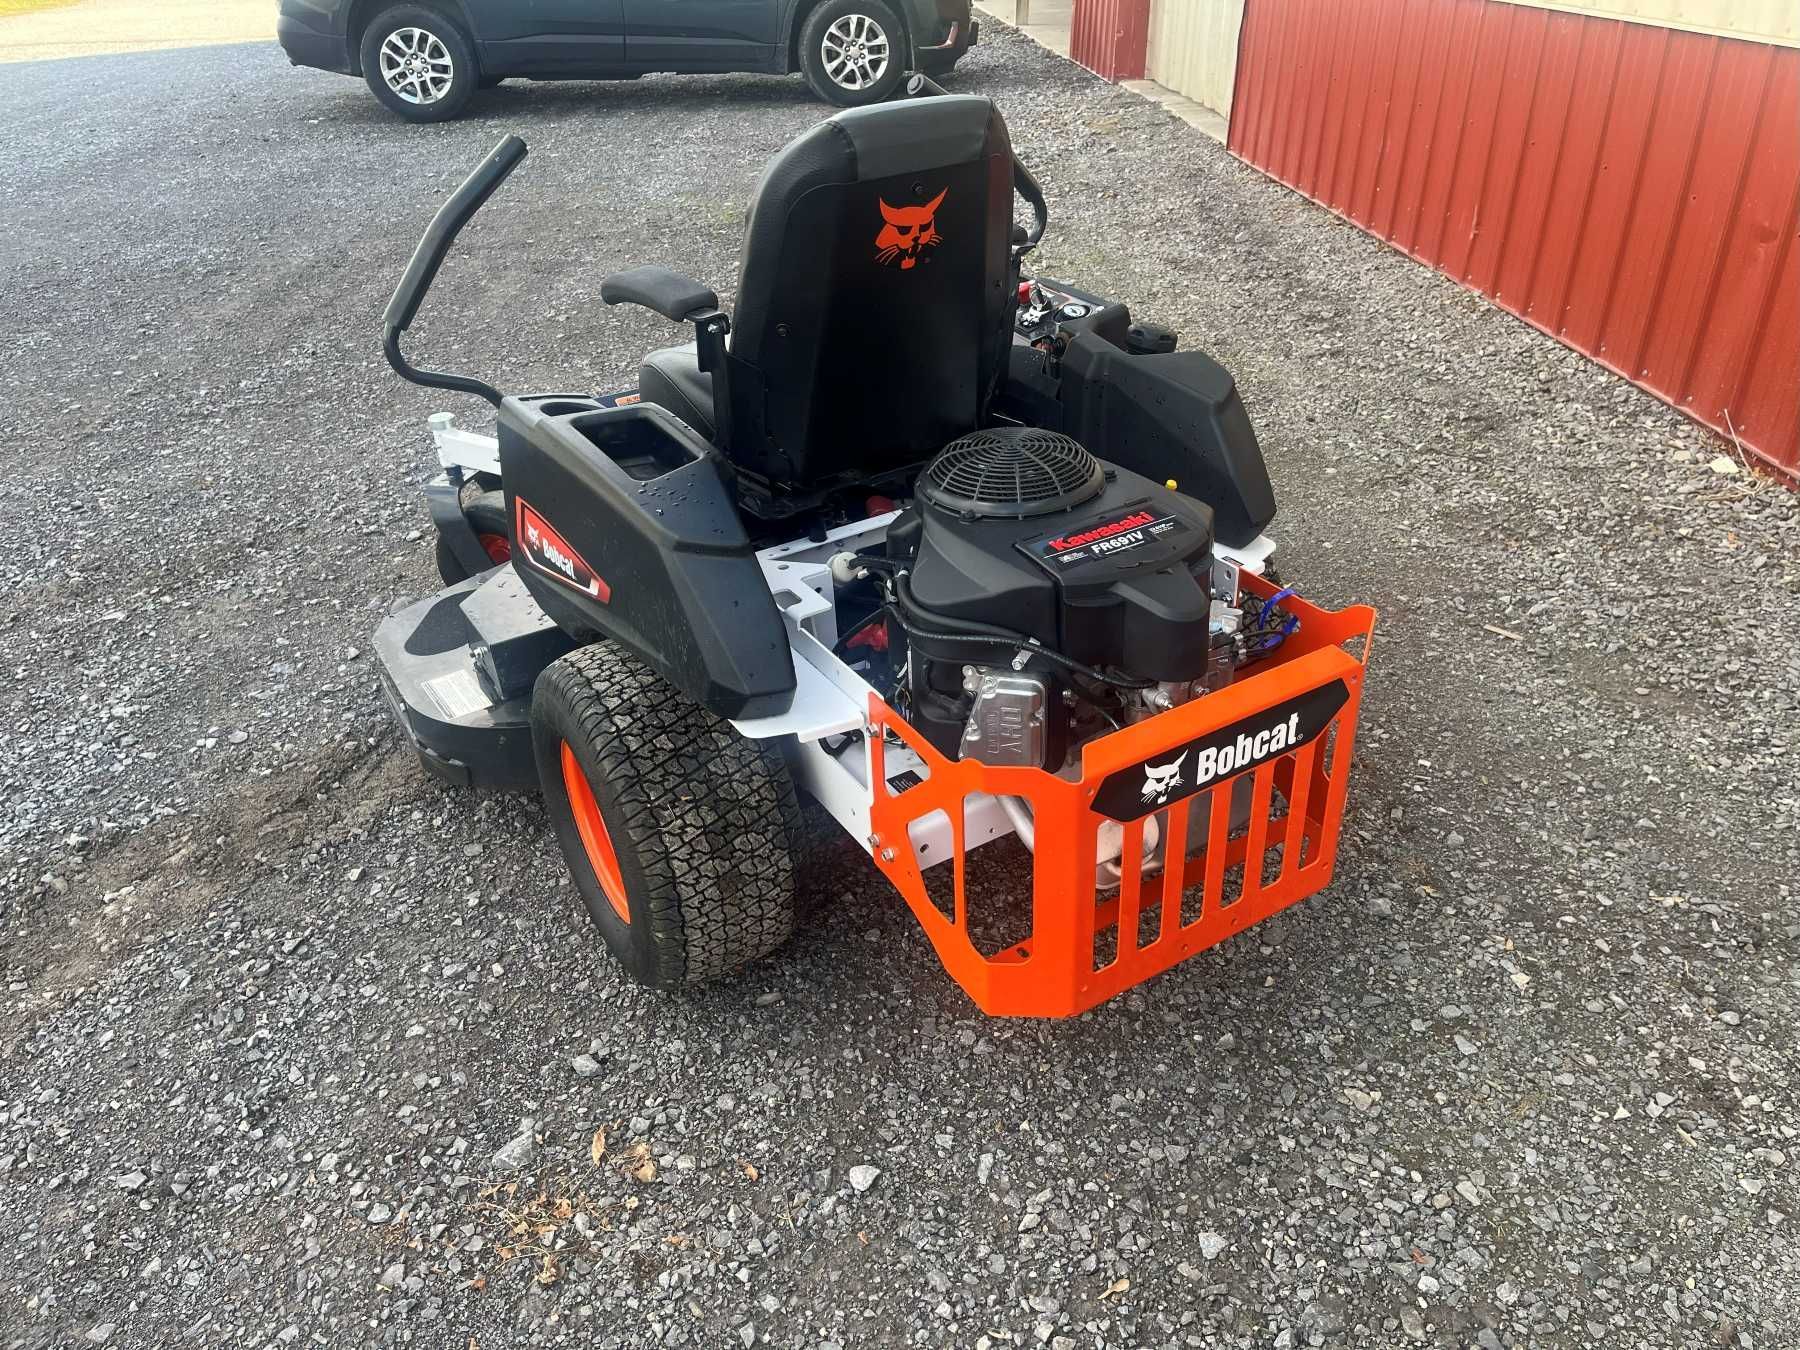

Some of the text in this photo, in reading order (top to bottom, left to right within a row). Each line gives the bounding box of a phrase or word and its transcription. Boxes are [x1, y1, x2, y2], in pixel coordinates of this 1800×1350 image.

[1049, 511, 1154, 551] Kawasaki
[1091, 531, 1144, 554] FR691V
[542, 537, 577, 580] Bobcat
[1196, 712, 1299, 785] Bobcat
